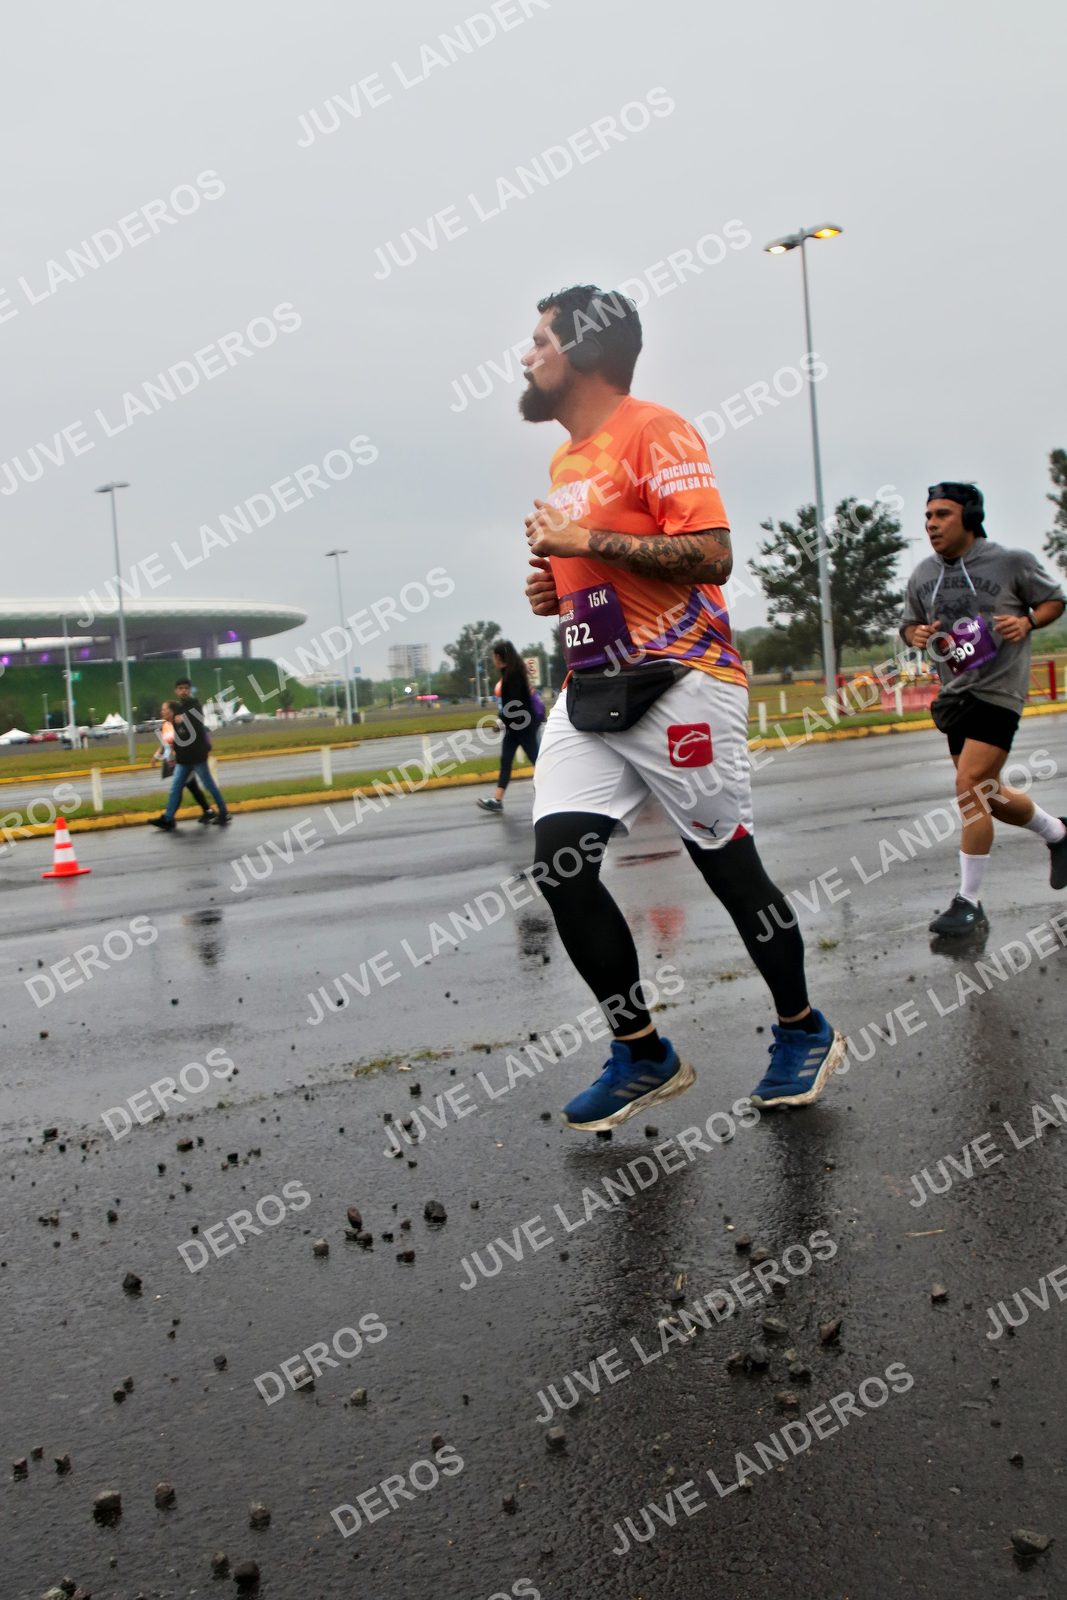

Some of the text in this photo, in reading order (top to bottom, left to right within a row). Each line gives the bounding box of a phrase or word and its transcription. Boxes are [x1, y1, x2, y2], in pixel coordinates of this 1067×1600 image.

[658, 476, 701, 499] IMPULSA
[916, 576, 1001, 598] UNIERSDAD
[588, 589, 608, 608] 15K
[565, 622, 594, 648] 622
